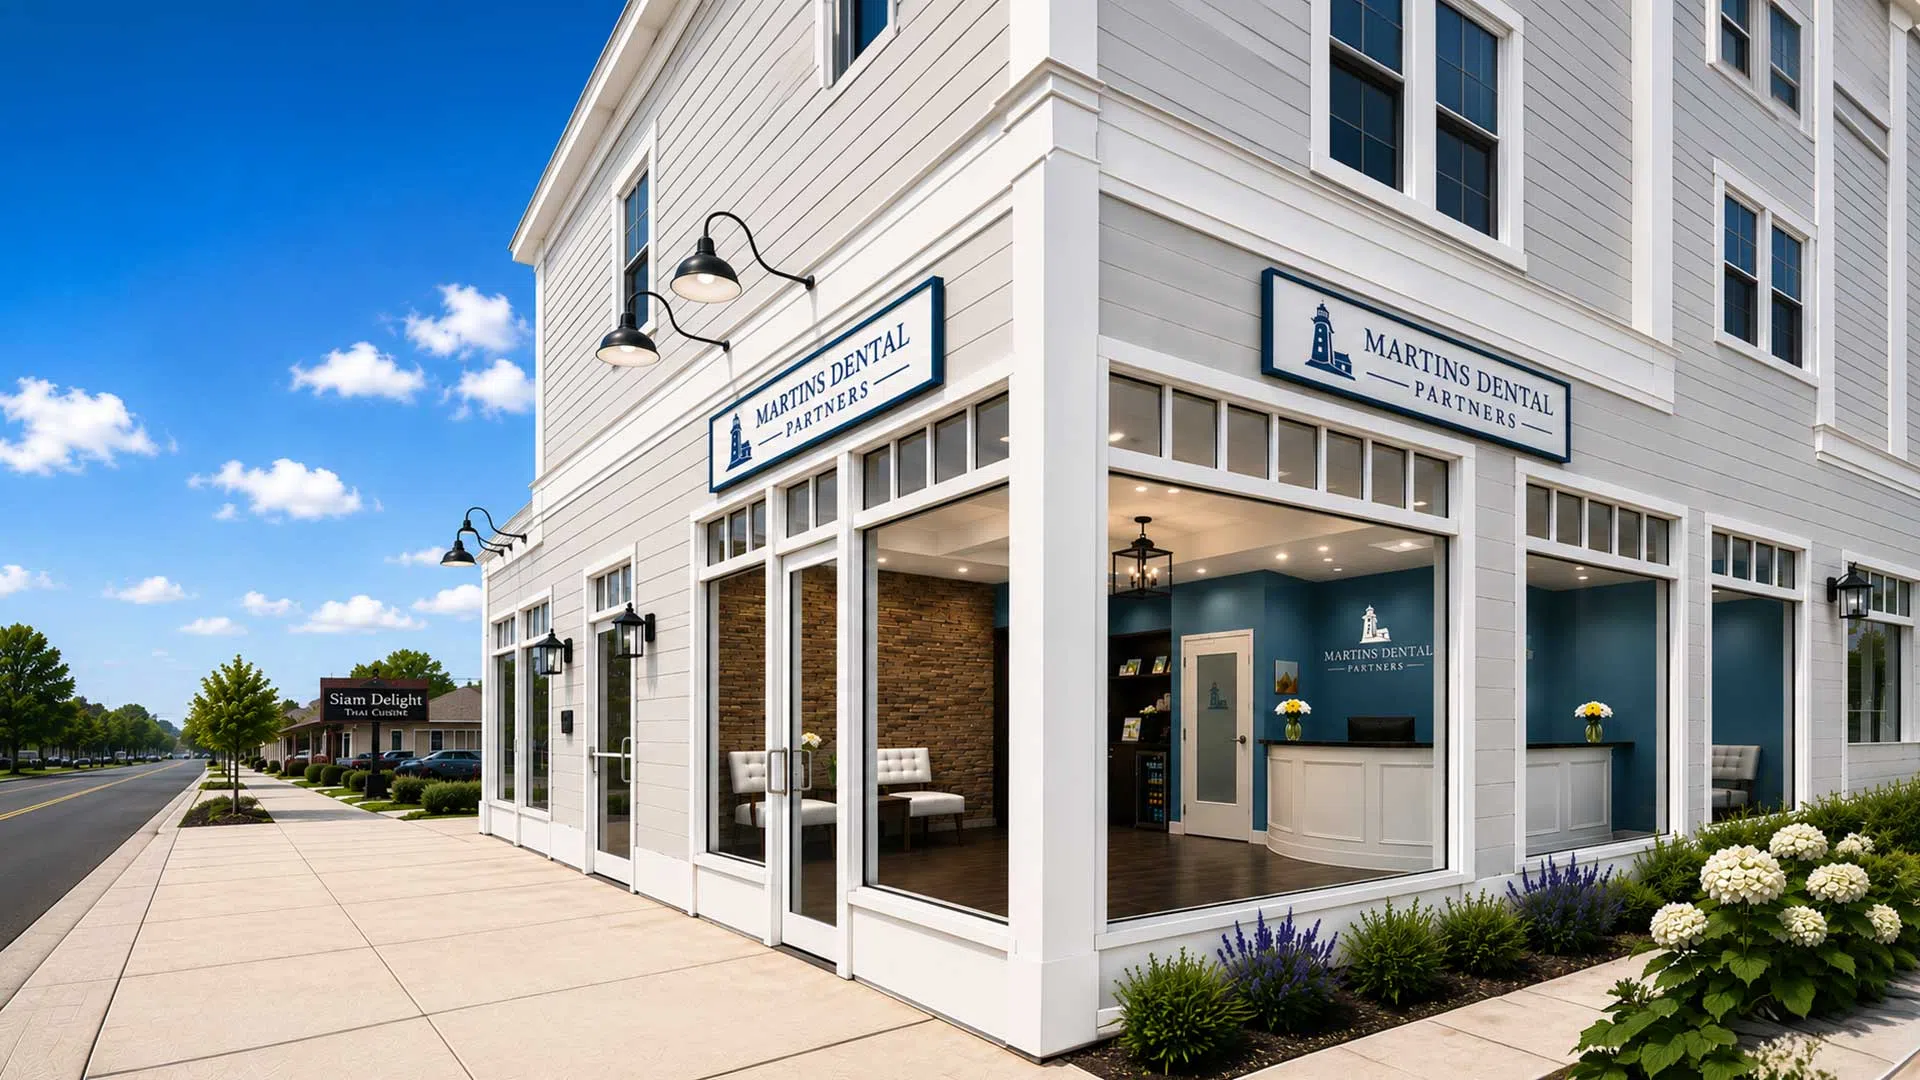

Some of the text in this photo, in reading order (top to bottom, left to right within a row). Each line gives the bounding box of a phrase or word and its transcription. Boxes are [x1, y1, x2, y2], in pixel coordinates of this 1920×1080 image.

[756, 323, 910, 428] MARTINS DENTAL
[1364, 327, 1554, 416] MARTINS DENTAL
[786, 380, 869, 438] PARTNERS
[1415, 380, 1516, 429] PARTNERS
[1324, 645, 1434, 662] MARTINS DENTAL
[1347, 662, 1404, 673] PARTNERS
[329, 692, 423, 709] Siam Delight
[344, 708, 409, 717] THAI CUISINE
